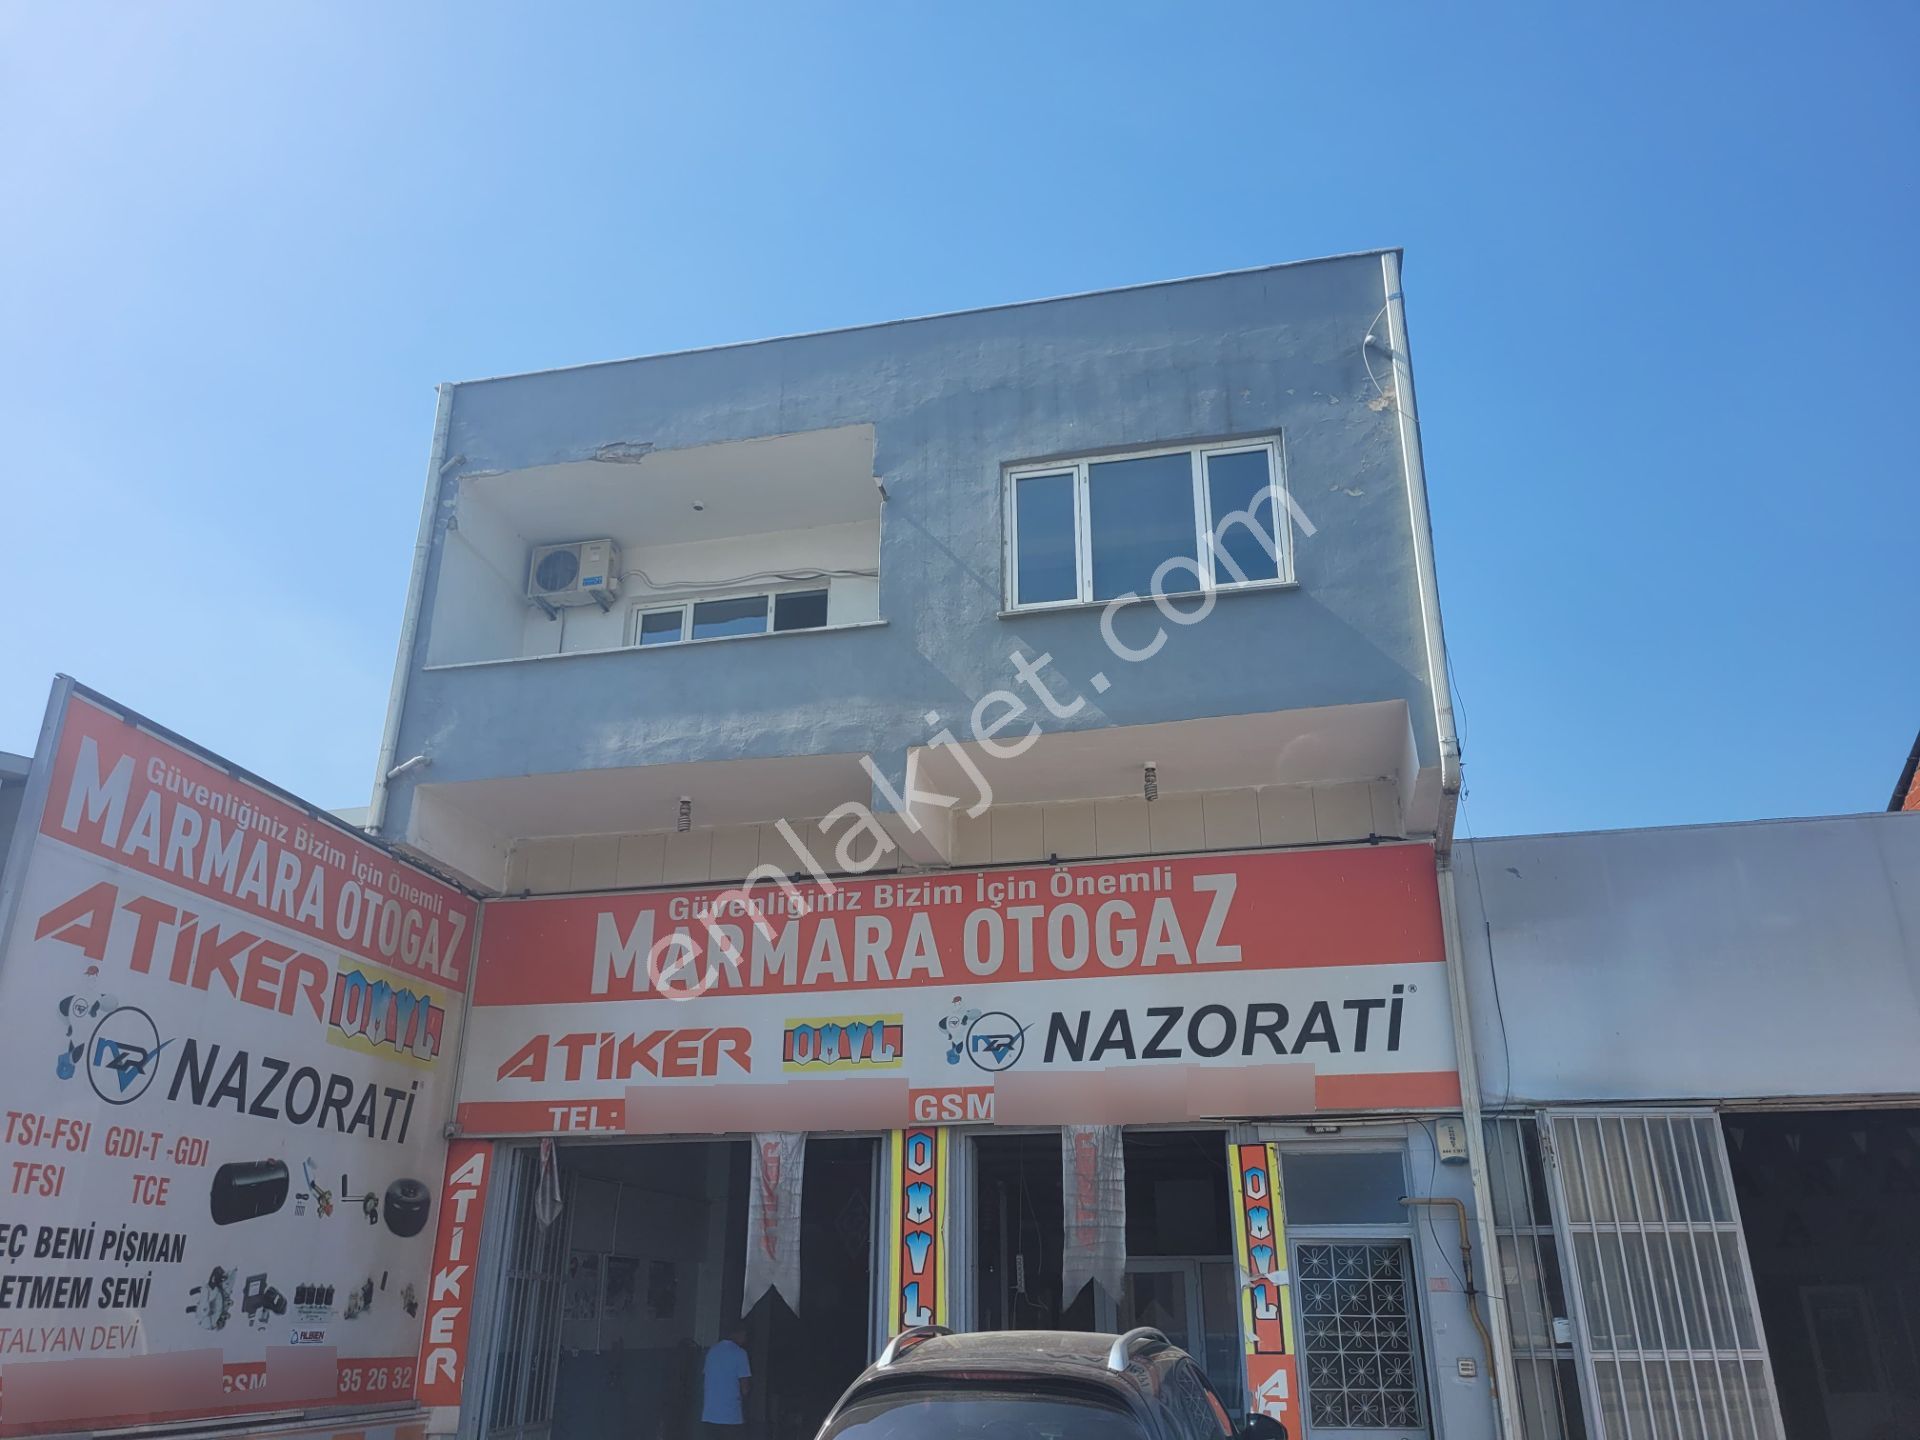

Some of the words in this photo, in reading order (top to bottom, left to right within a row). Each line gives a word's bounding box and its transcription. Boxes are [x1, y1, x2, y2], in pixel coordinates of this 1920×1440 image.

[61, 735, 325, 930] MARMARA
[336, 880, 467, 982] OTOGAZ
[146, 756, 289, 843] Güvenliğiniz
[294, 827, 346, 870] Bizim
[352, 851, 383, 887] İçin
[388, 869, 443, 915] Önemli
[668, 888, 862, 920] Güvenliğiniz
[874, 878, 962, 909] Bizim
[976, 872, 1037, 908] İçin
[1050, 866, 1172, 898] Önemli
[589, 908, 945, 995] MARMARA
[963, 873, 1242, 976] OTOGAZ
[1043, 983, 1405, 1064] NAZORATİ
[168, 1038, 418, 1144] NAZORATİ
[548, 1105, 618, 1132] TEL:
[914, 1093, 995, 1122] GSM
[5, 1111, 91, 1152] TSI-FSI
[12, 1162, 65, 1197] TFSI
[132, 1174, 170, 1206] TCE
[34, 1221, 95, 1260] BENİ
[99, 1223, 187, 1267] PİŞMAN
[0, 1275, 93, 1309] ETMEM
[98, 1271, 152, 1309] SENİ
[91, 1320, 140, 1351] DEVİ
[340, 1368, 362, 1392] 35
[366, 1368, 388, 1391] 26
[392, 1366, 412, 1389] 32
